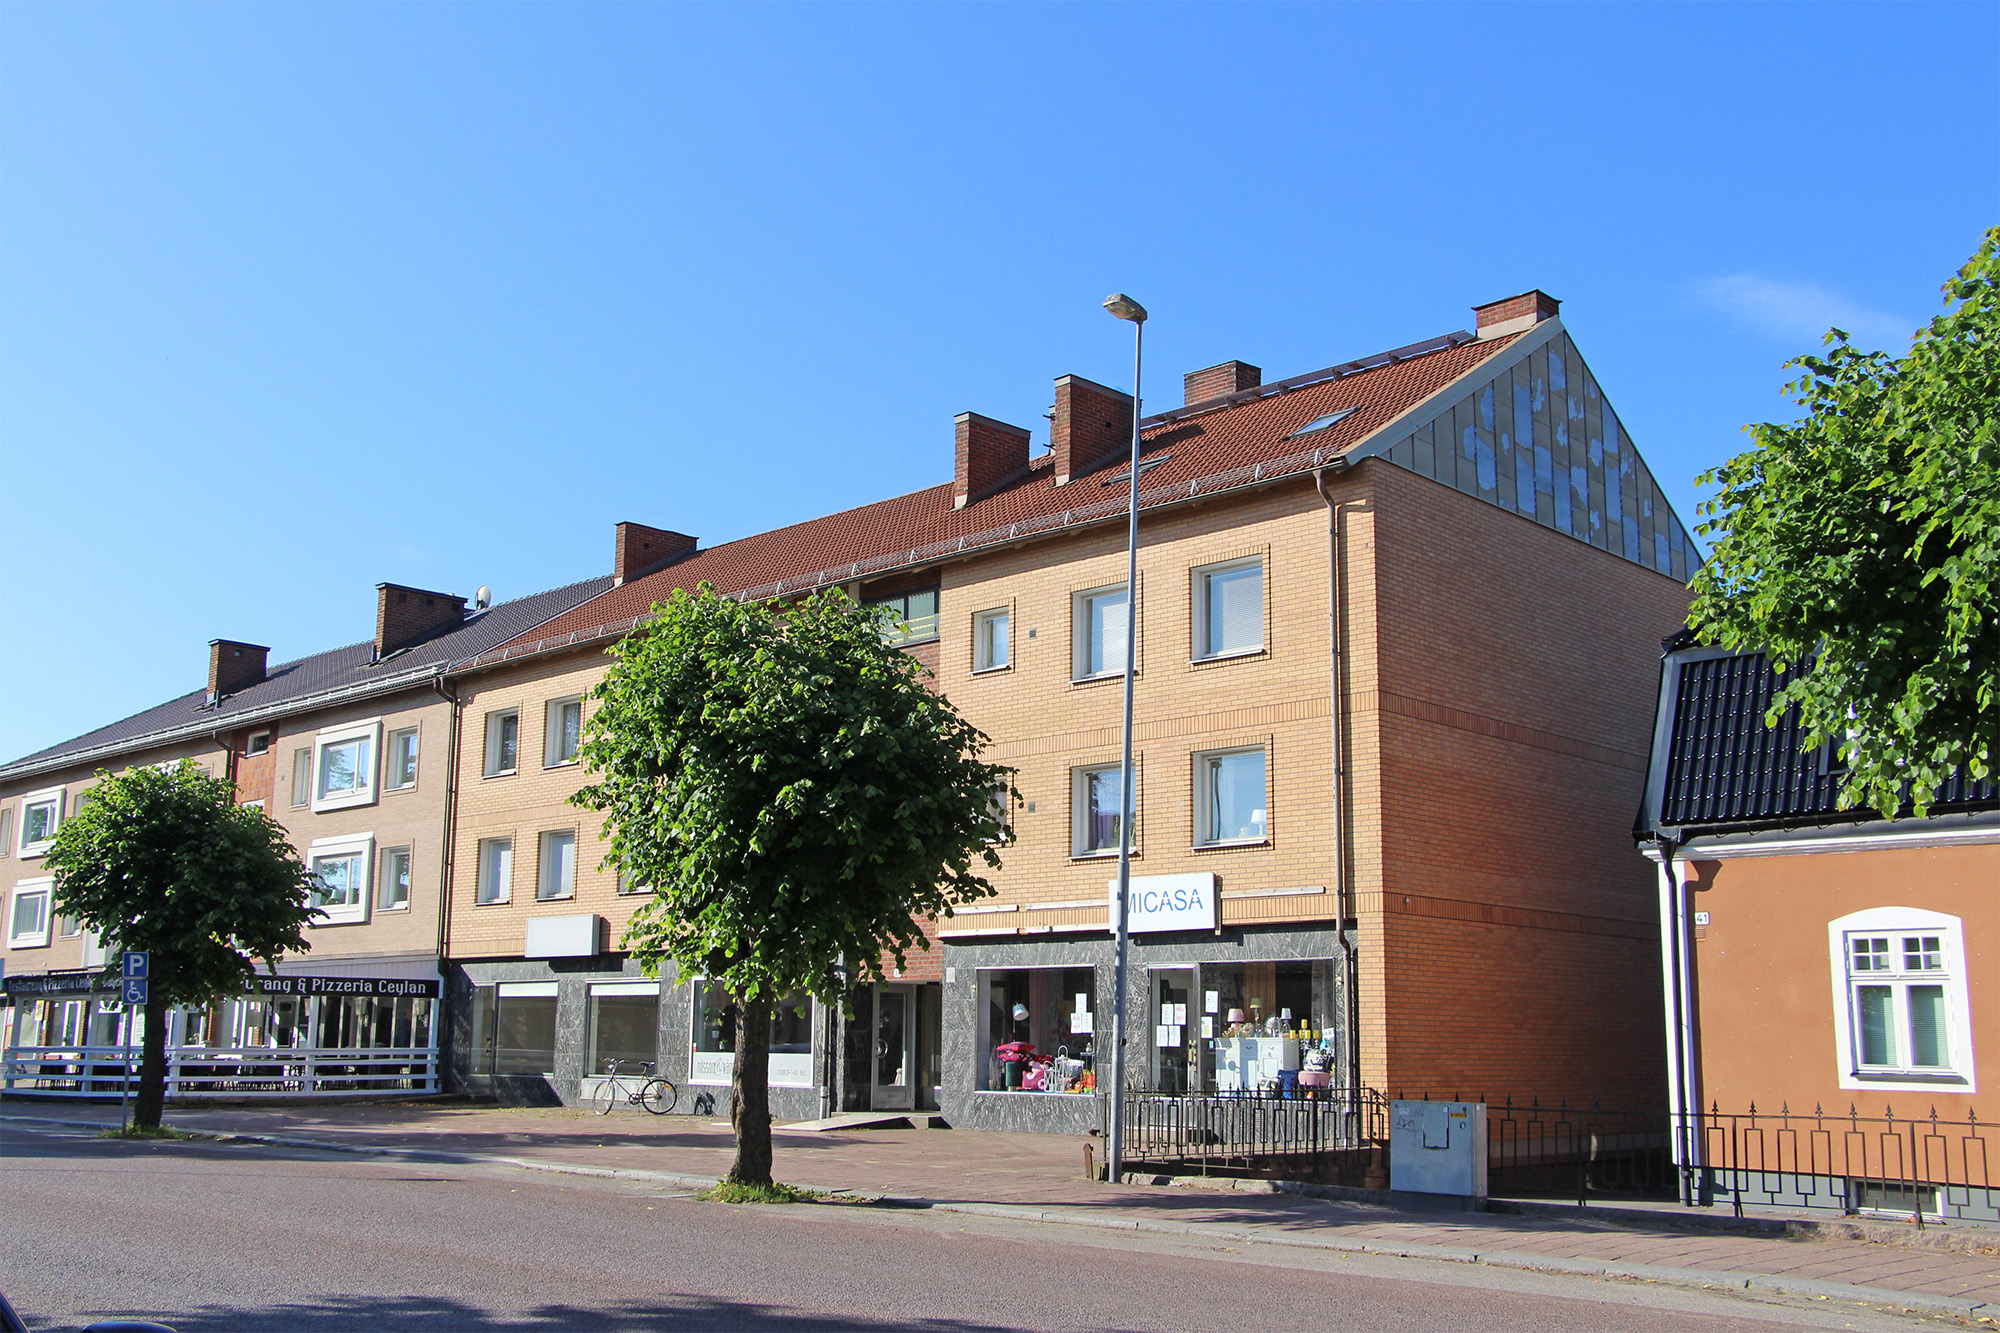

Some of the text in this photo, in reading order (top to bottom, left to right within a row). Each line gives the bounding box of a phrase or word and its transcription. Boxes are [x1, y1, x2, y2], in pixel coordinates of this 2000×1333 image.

[1697, 913, 1708, 923] 41
[129, 955, 144, 976] P
[297, 978, 307, 994] &
[311, 978, 373, 993] Pizzeria
[378, 980, 426, 996] Ceylan
